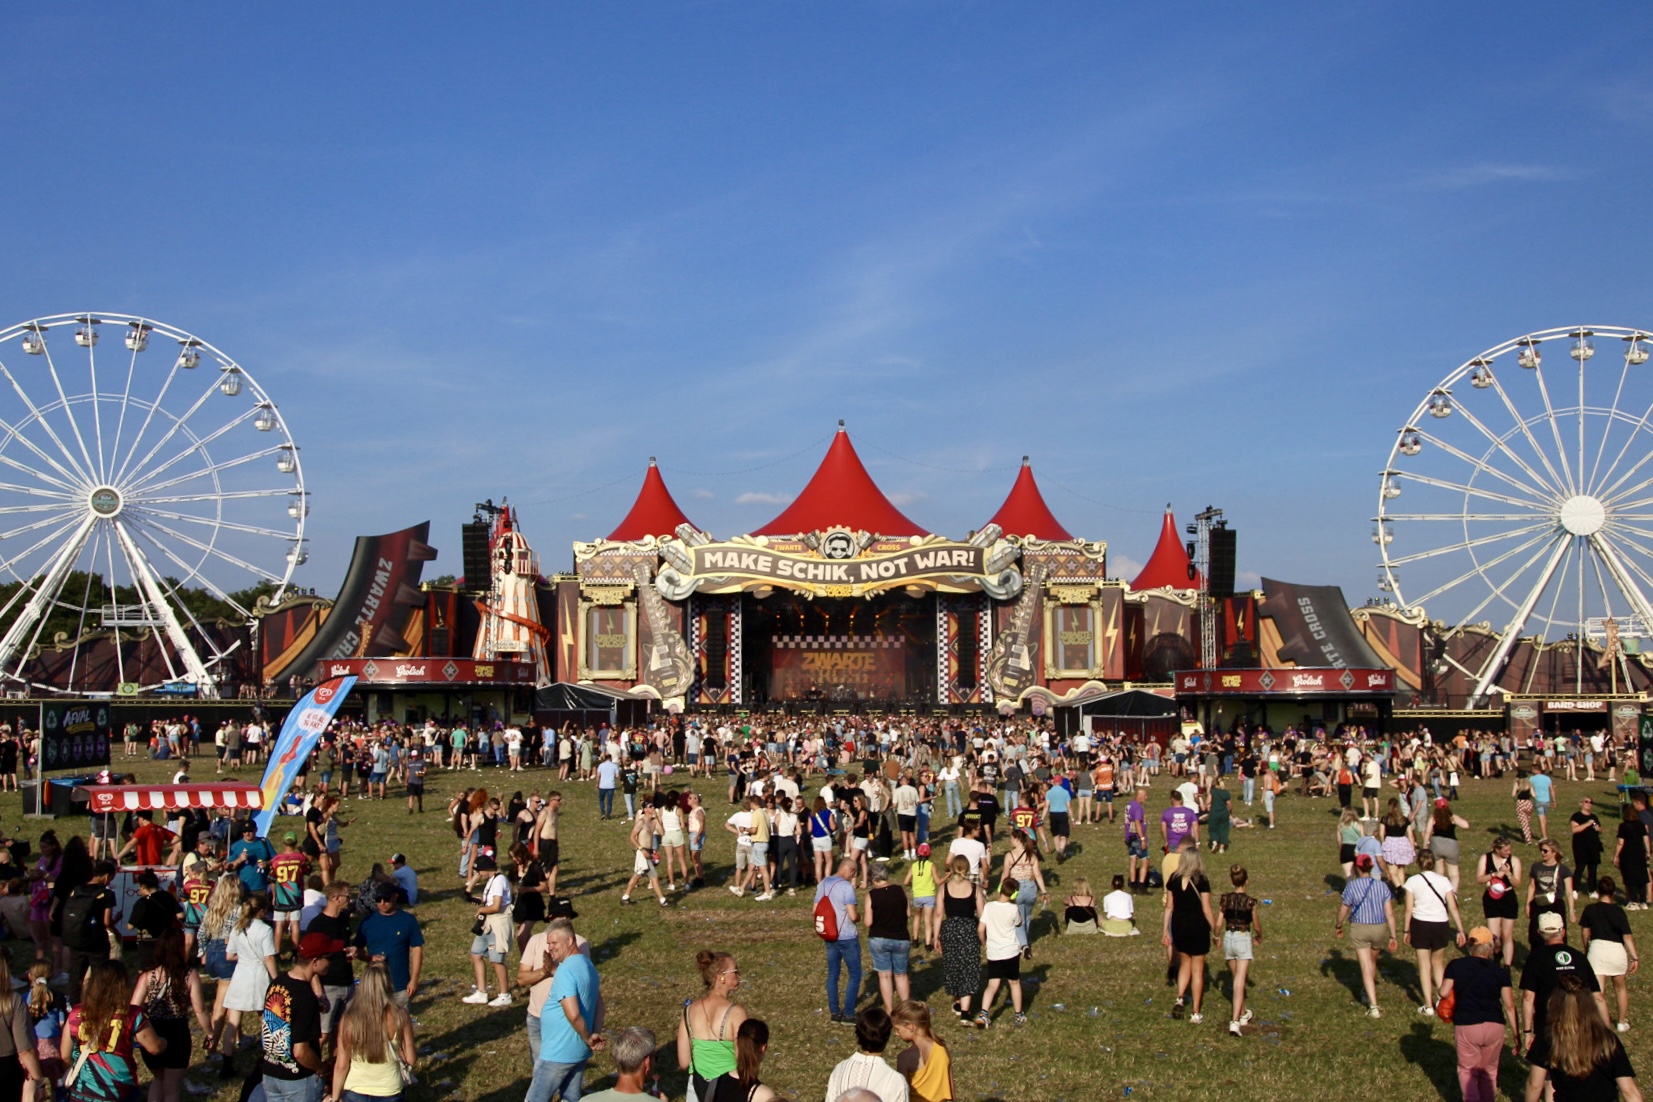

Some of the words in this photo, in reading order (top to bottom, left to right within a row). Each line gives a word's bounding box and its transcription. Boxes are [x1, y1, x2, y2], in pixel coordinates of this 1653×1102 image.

[704, 552, 773, 573] MAKE
[776, 559, 854, 583] SCHIK,
[860, 557, 909, 580] NOT
[914, 550, 975, 570] WAR!
[1297, 597, 1326, 640] CROSS
[801, 652, 877, 671] ZWARTE
[395, 664, 426, 678] Grolsch
[1292, 674, 1324, 688] Grolsch
[1016, 814, 1033, 828] 97
[276, 865, 299, 883] 97
[189, 889, 210, 904] 97
